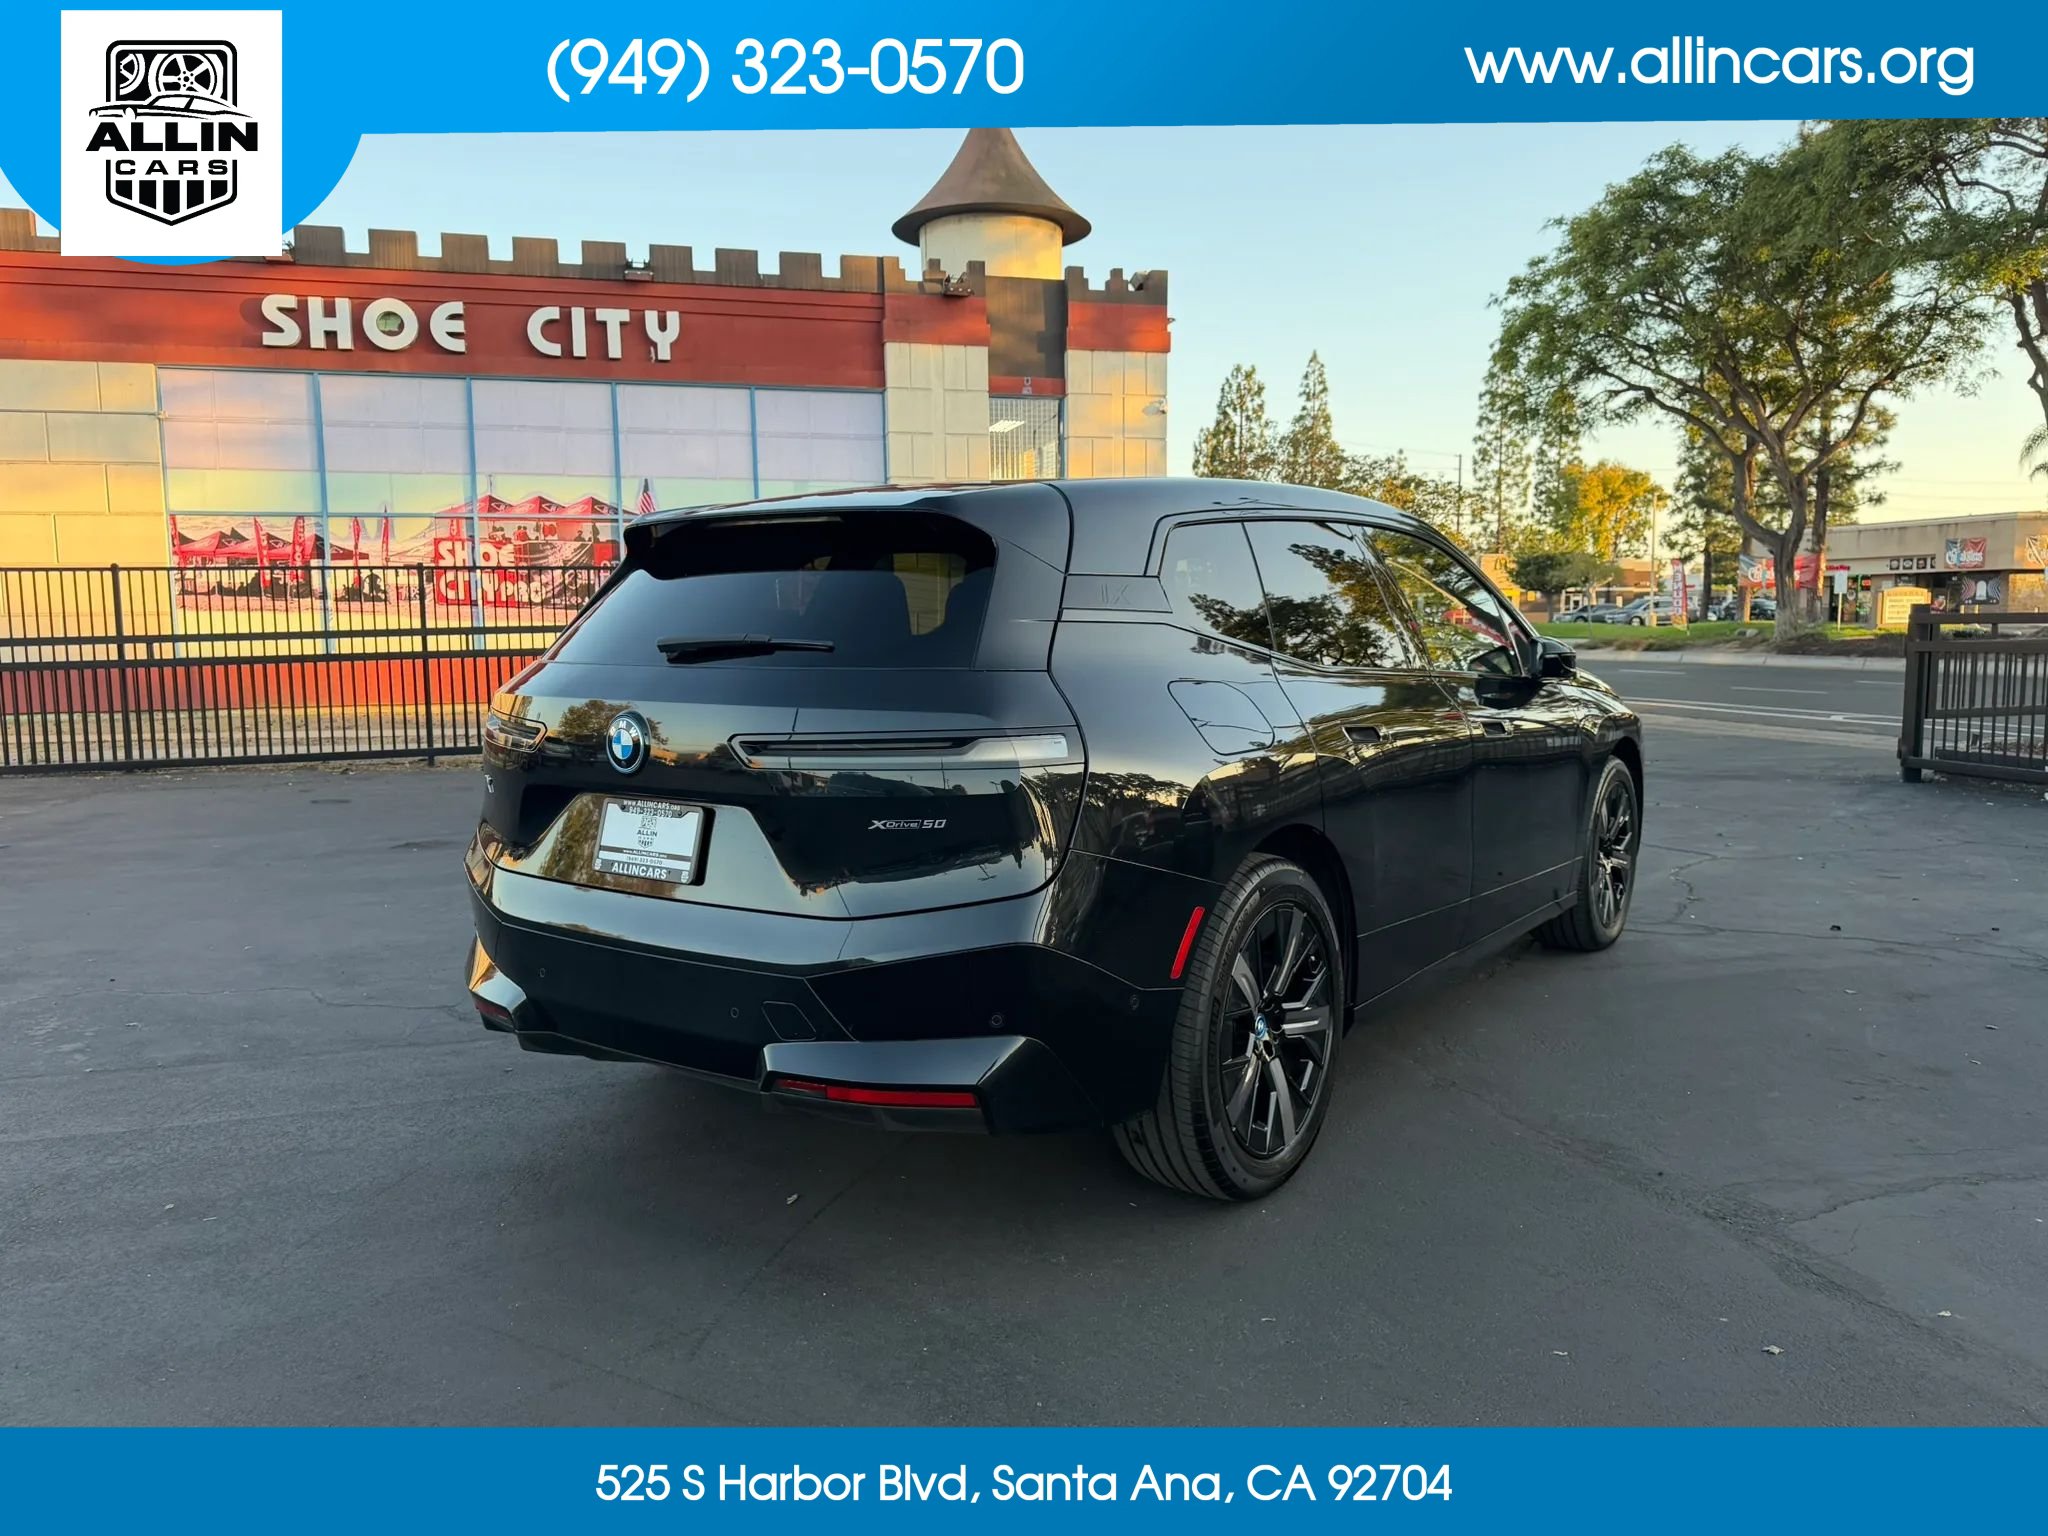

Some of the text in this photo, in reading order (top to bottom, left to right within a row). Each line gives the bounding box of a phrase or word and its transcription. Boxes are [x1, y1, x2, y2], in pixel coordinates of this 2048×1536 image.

[261, 293, 680, 361] SHOE CITY
[438, 540, 515, 569] SHOE
[636, 829, 658, 837] ALLIN
[921, 819, 947, 829] 50
[611, 861, 668, 880] ALLINCARS
